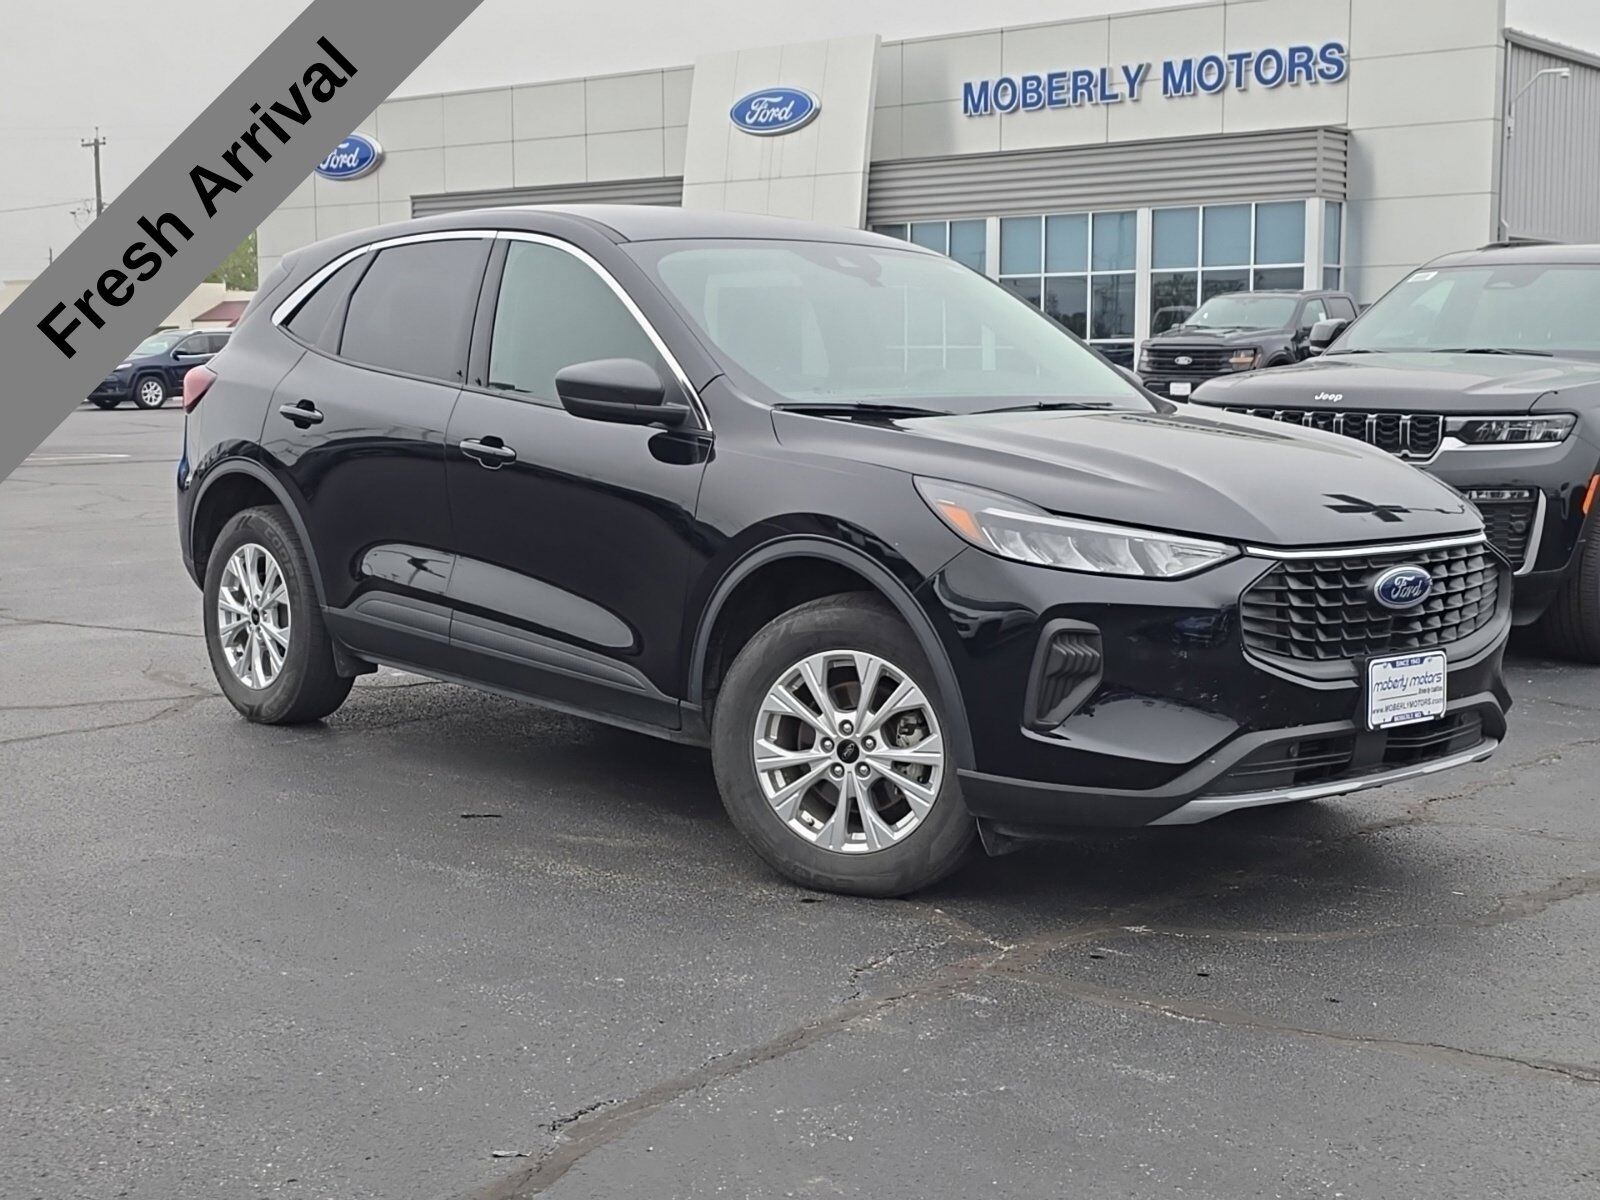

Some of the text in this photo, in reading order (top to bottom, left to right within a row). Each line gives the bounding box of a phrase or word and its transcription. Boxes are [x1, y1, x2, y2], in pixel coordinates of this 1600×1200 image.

[962, 42, 1347, 116] MOBERLY MOTORS
[745, 96, 795, 124] Ford
[1314, 391, 1343, 403] Jeep
[1391, 576, 1423, 599] Ford
[1373, 675, 1409, 692] moberly
[1409, 671, 1443, 687] motors
